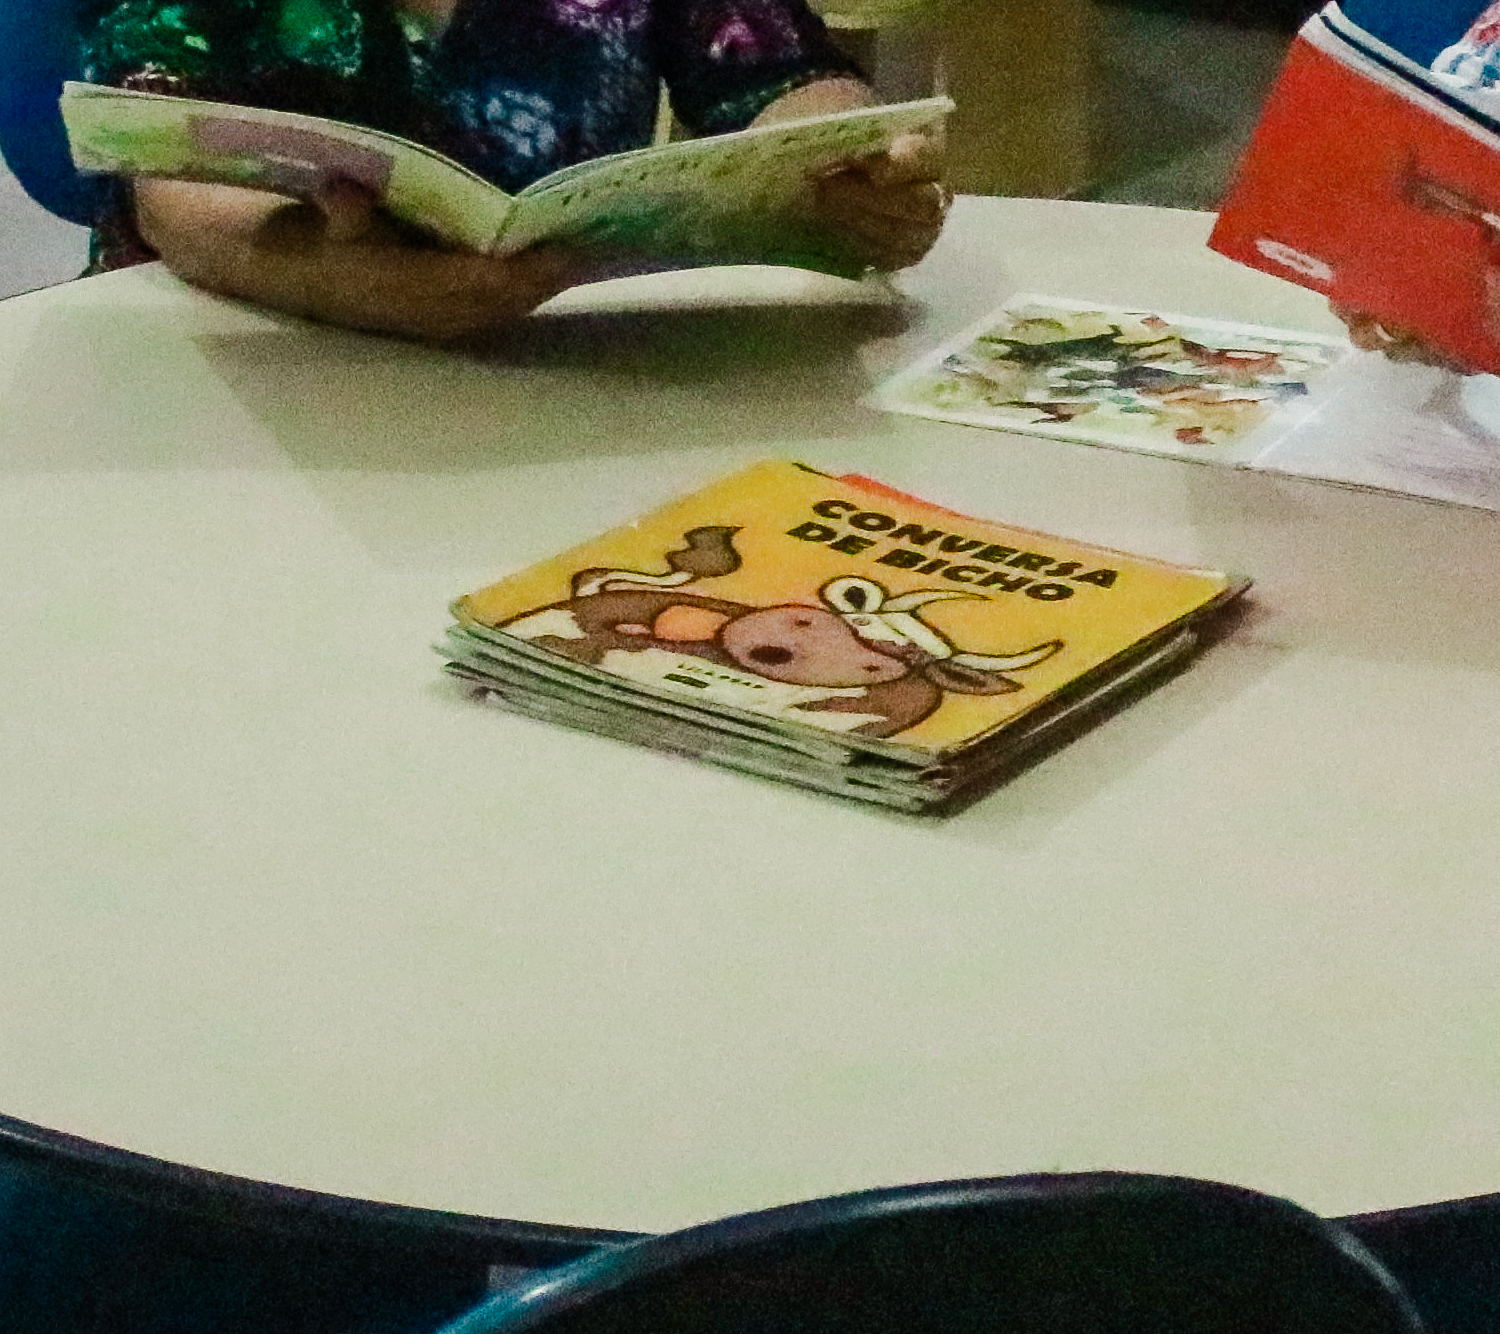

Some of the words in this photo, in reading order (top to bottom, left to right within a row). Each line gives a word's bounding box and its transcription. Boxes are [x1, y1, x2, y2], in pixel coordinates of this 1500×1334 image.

[784, 520, 877, 556] DE
[874, 548, 1075, 601] BICHO
[811, 498, 1119, 589] CONVERSA
